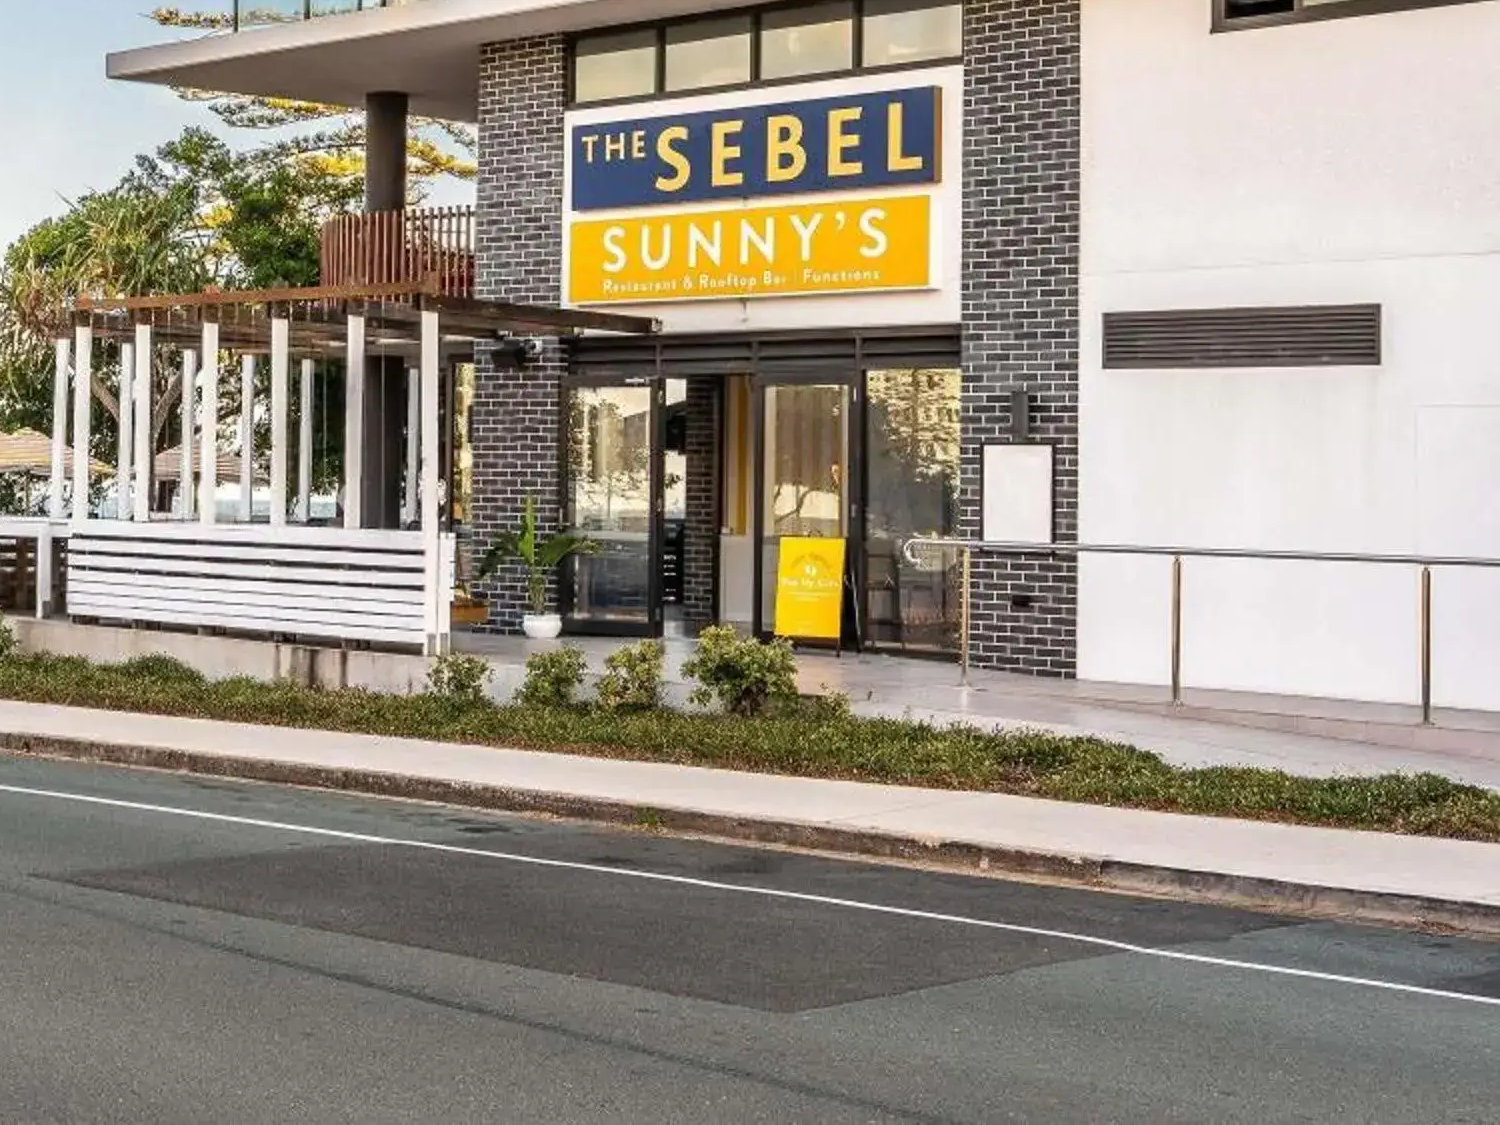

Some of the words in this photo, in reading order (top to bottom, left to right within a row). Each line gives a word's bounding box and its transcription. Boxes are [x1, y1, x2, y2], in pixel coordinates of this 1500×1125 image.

[581, 130, 646, 163] THE
[655, 102, 923, 192] SEBEL
[602, 207, 888, 272] SUNNY'S
[700, 272, 757, 292] Rooftop
